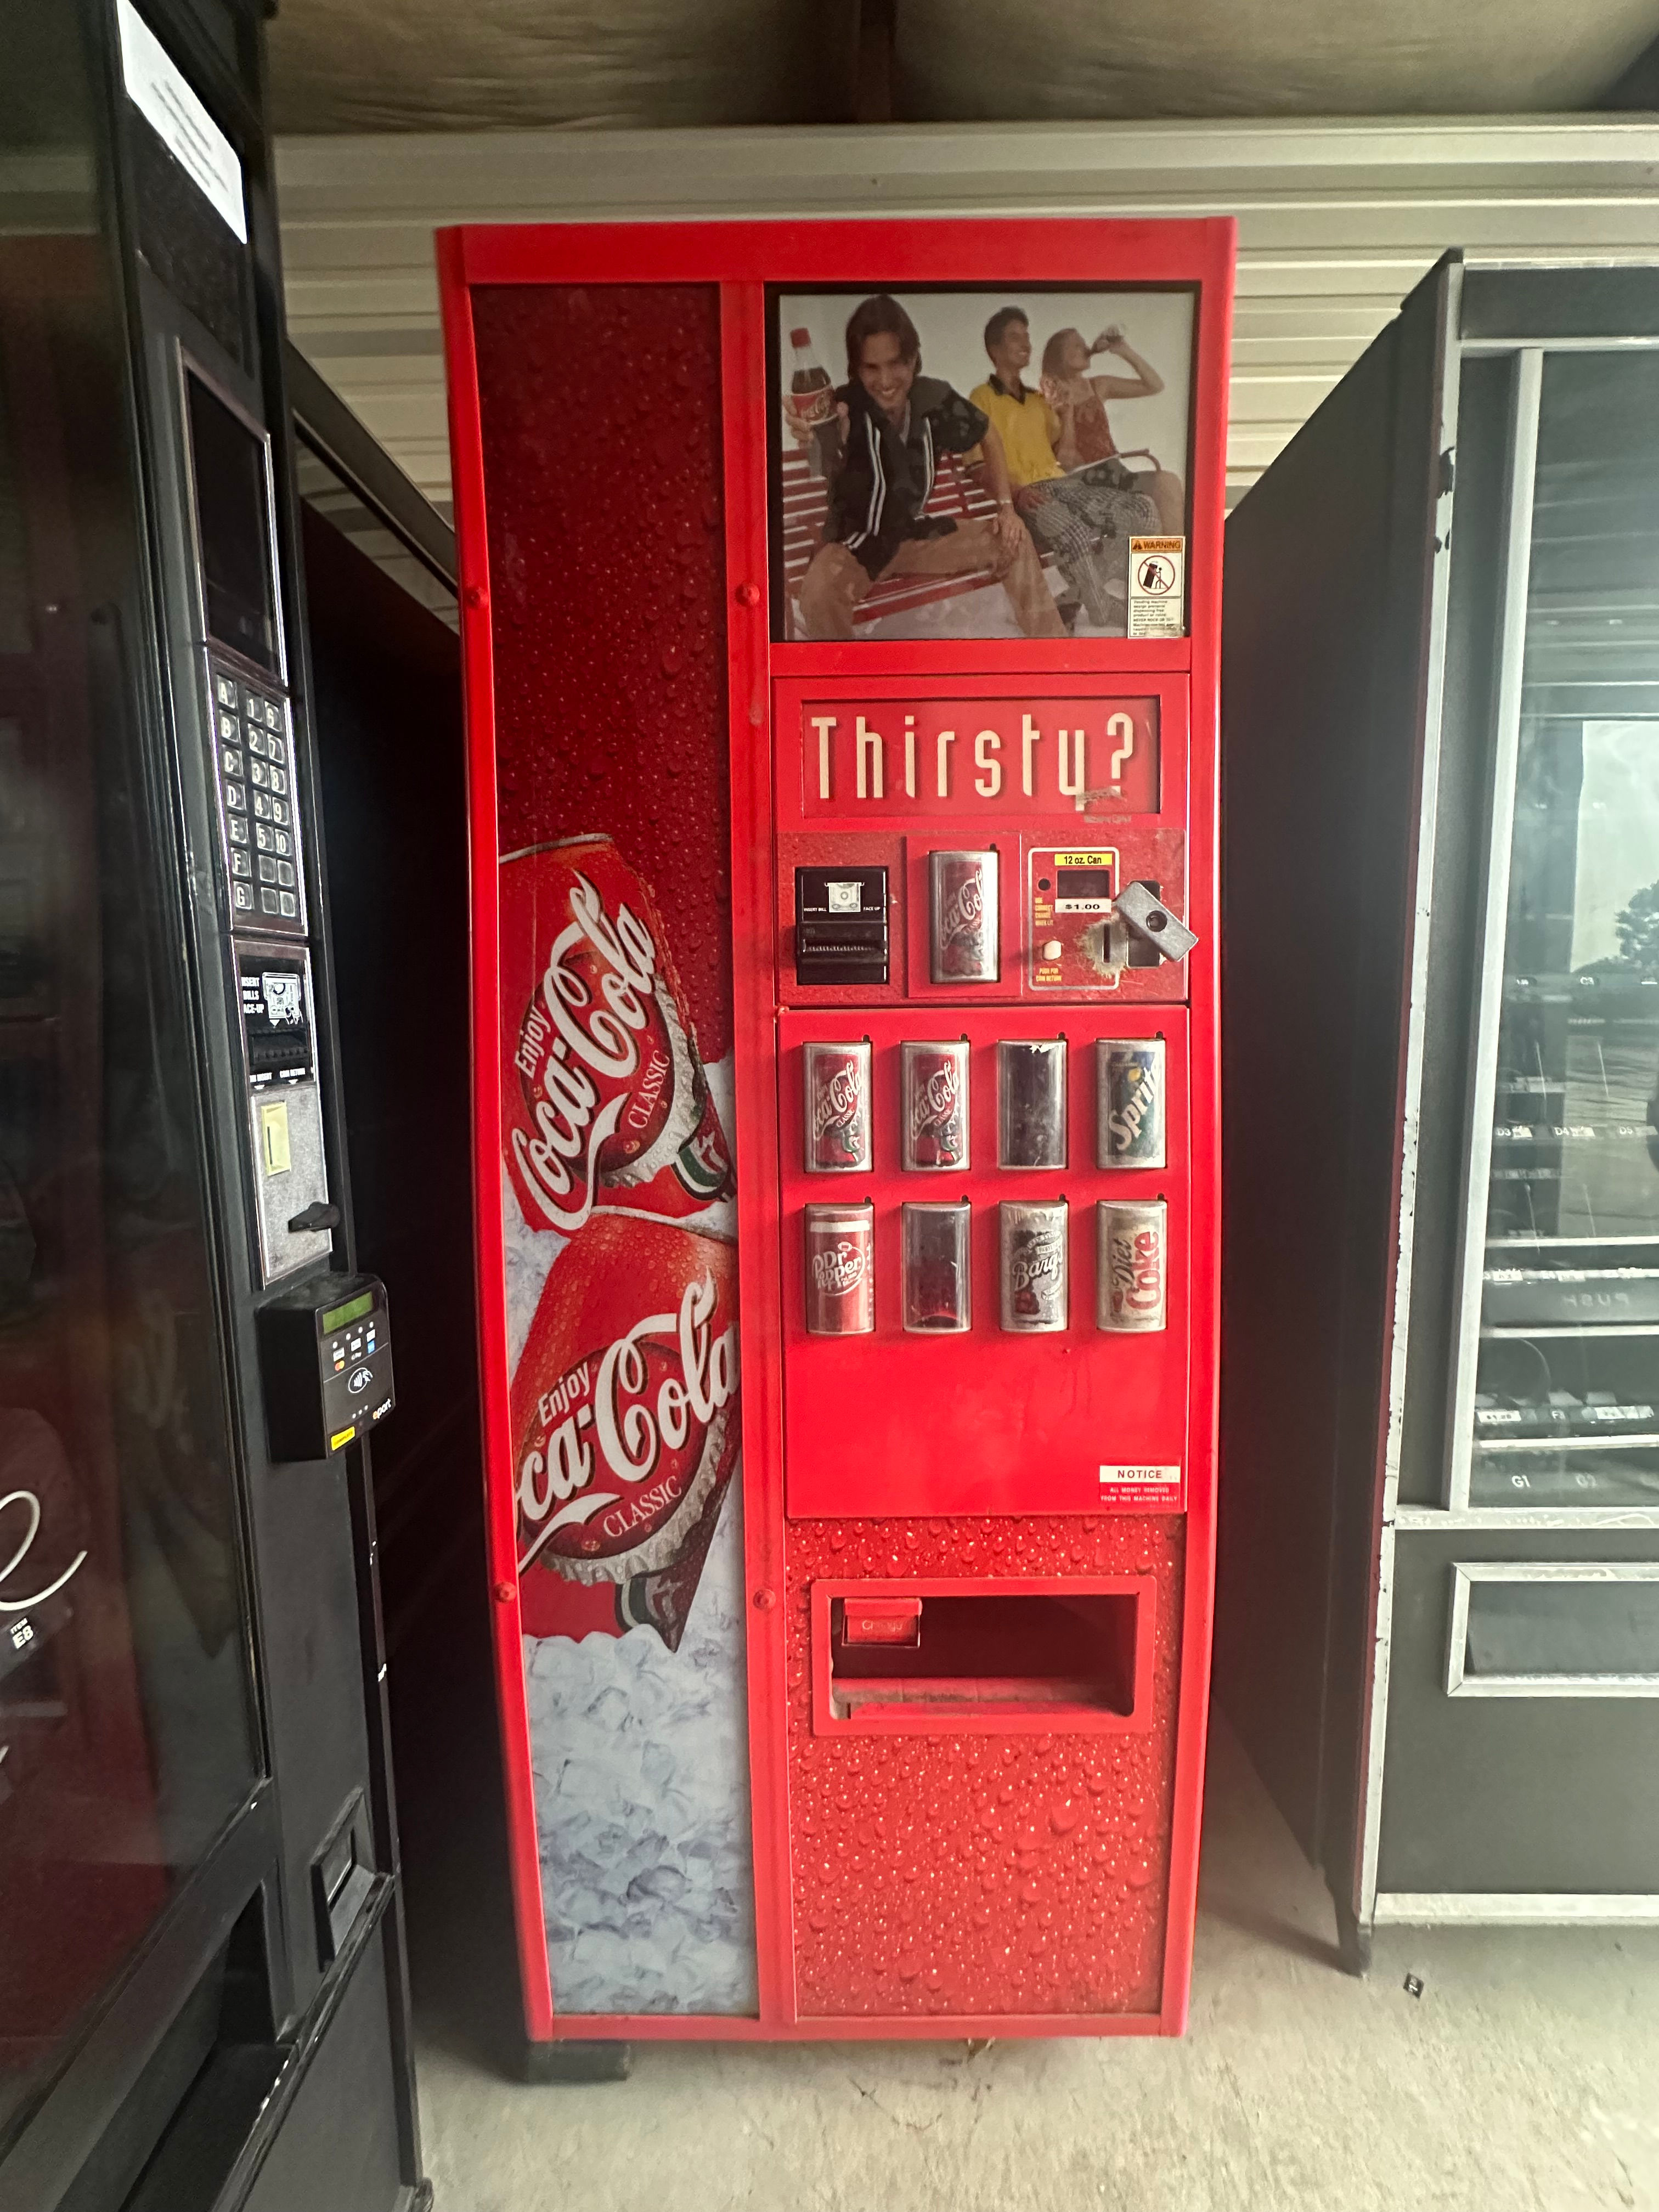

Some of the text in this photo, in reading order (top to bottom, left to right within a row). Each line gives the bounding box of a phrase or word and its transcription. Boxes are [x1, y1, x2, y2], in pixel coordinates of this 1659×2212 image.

[1143, 540, 1181, 549] WARNING
[220, 682, 228, 705] A
[249, 698, 255, 718] 1
[267, 708, 274, 728] 6
[221, 716, 231, 738] B
[249, 731, 258, 752] 2
[269, 739, 276, 758] 7
[225, 751, 234, 772] C
[811, 712, 1133, 811] Thirsty?
[252, 763, 261, 783] 3
[272, 771, 279, 791] 8
[227, 785, 237, 806] D
[256, 796, 263, 815] 4
[274, 803, 282, 822] 9
[230, 819, 240, 840] E
[258, 827, 266, 848] 5
[275, 833, 286, 853] 10
[234, 852, 241, 871] F
[1064, 856, 1073, 864] 12
[1087, 856, 1102, 864] Can
[236, 886, 245, 906] G
[243, 1003, 264, 1014] ACE-UP
[511, 868, 657, 1231] Coca-Cola
[514, 1004, 551, 1080] Enjoy
[628, 1049, 670, 1130] CLASSIC
[1497, 1127, 1511, 1136] D3
[1555, 1126, 1570, 1136] D4
[823, 1251, 848, 1269] Dr
[812, 1255, 862, 1291] Pepper
[1126, 1231, 1161, 1310] Coke
[538, 1362, 591, 1426] Enjoy
[516, 1266, 740, 1575] ca-Cola
[1118, 1470, 1163, 1479] NOTICE
[1511, 1474, 1531, 1488] G1
[603, 1475, 683, 1538] CLASSIC
[13, 1625, 33, 1649] E8
